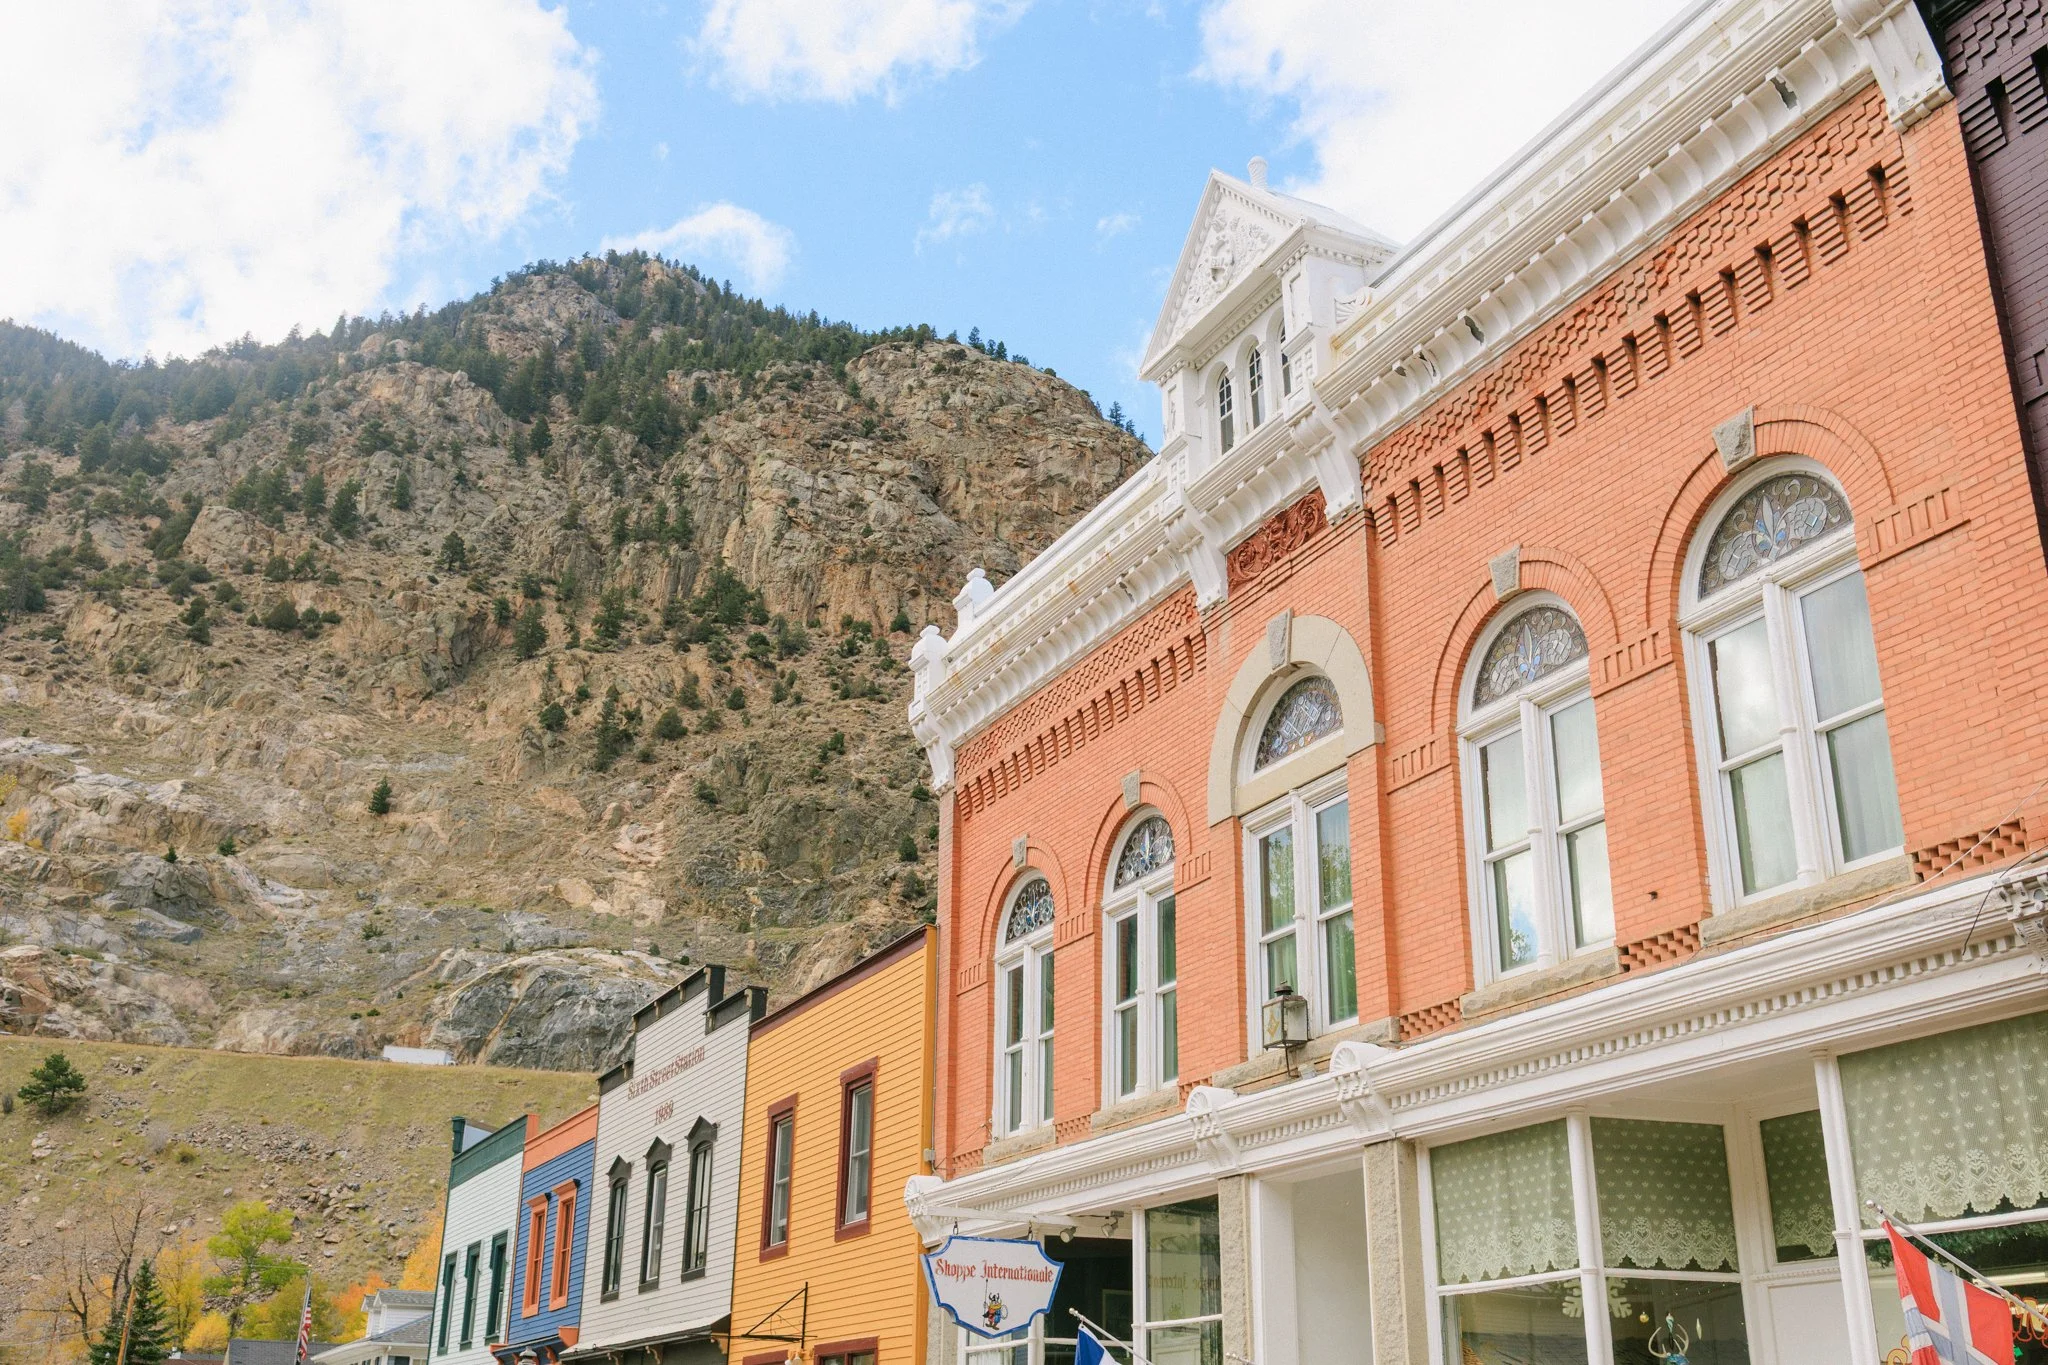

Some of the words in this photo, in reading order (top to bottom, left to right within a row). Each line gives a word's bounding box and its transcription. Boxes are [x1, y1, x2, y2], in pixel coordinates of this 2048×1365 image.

[650, 1062, 675, 1091] Street
[674, 1045, 705, 1076] Station
[935, 1258, 976, 1282] Shoppe
[980, 1260, 1054, 1283] Internationale
